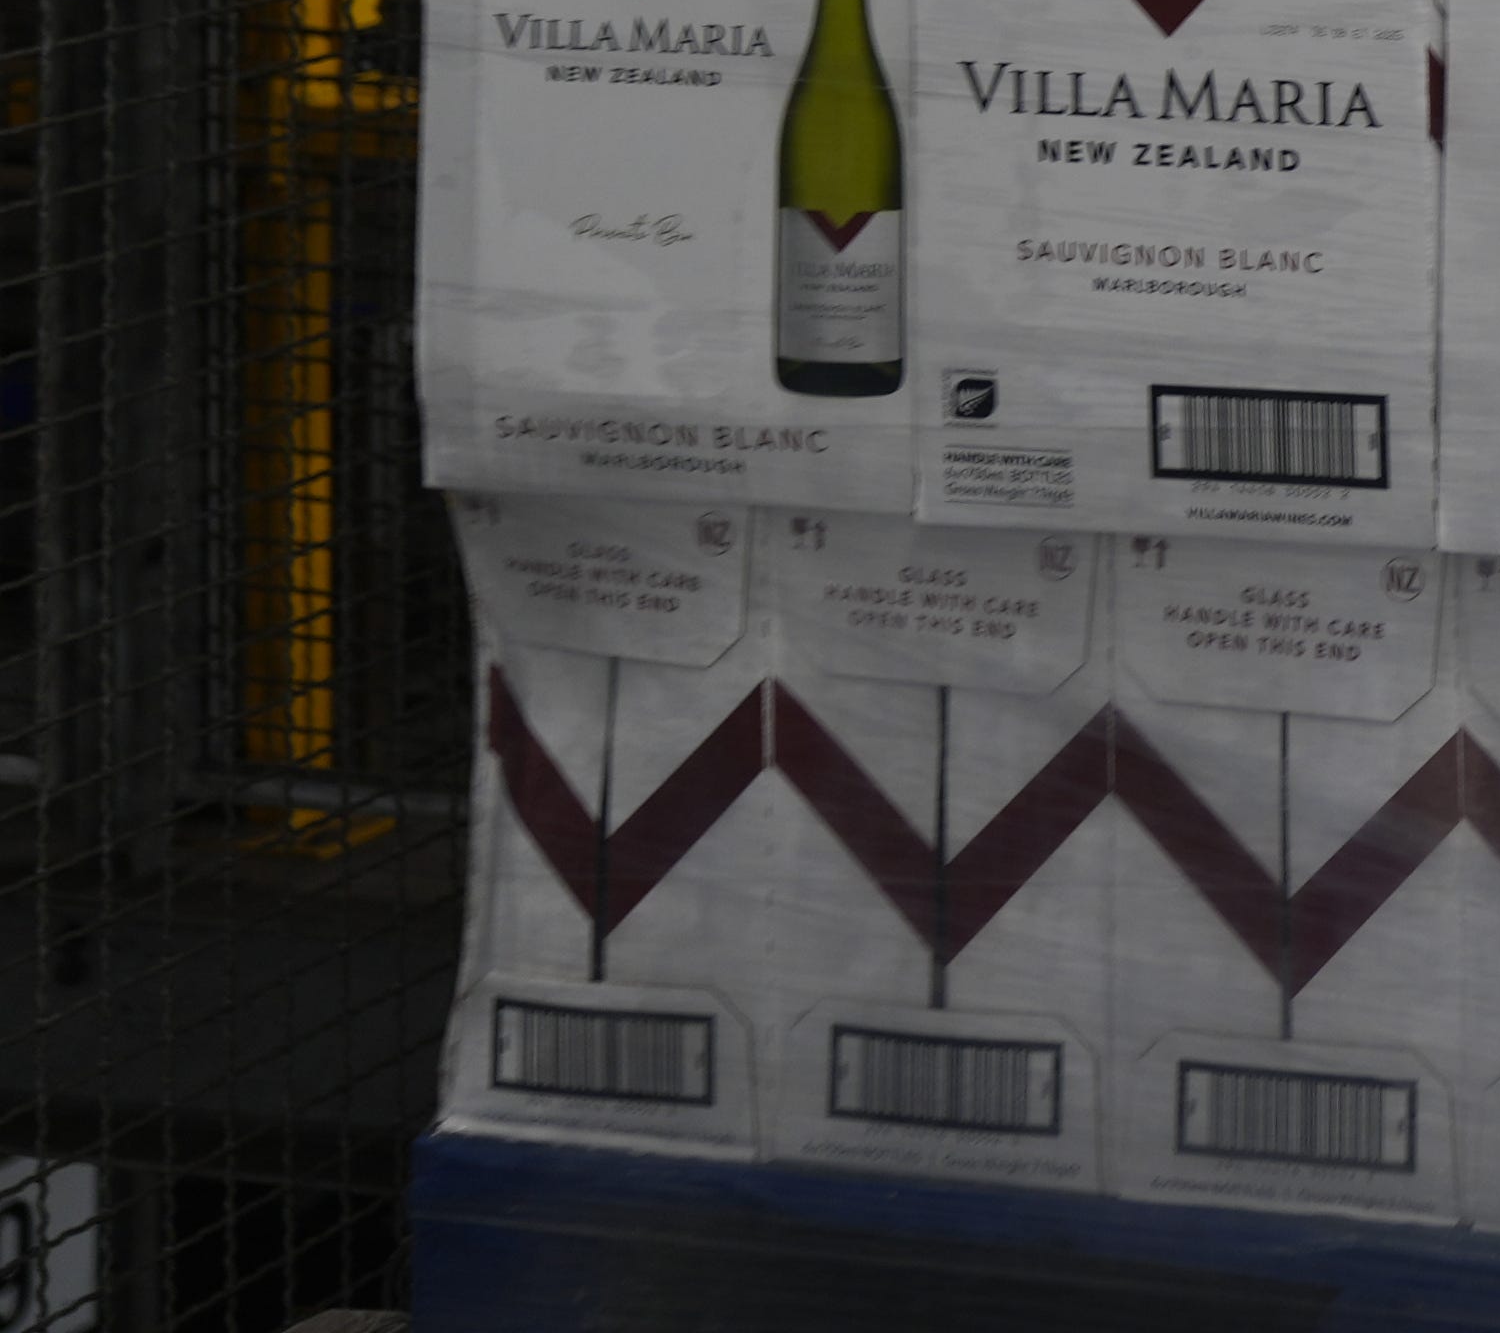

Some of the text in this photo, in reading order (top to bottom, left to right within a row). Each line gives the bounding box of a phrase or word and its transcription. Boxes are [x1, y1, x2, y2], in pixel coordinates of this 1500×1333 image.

[957, 61, 1382, 128] VILLA MARIA
[1040, 140, 1299, 171] NEW ZEALAND
[1017, 239, 1323, 273] SAUVIGNON BLANC
[1093, 277, 1246, 297] MARLBOROUGH
